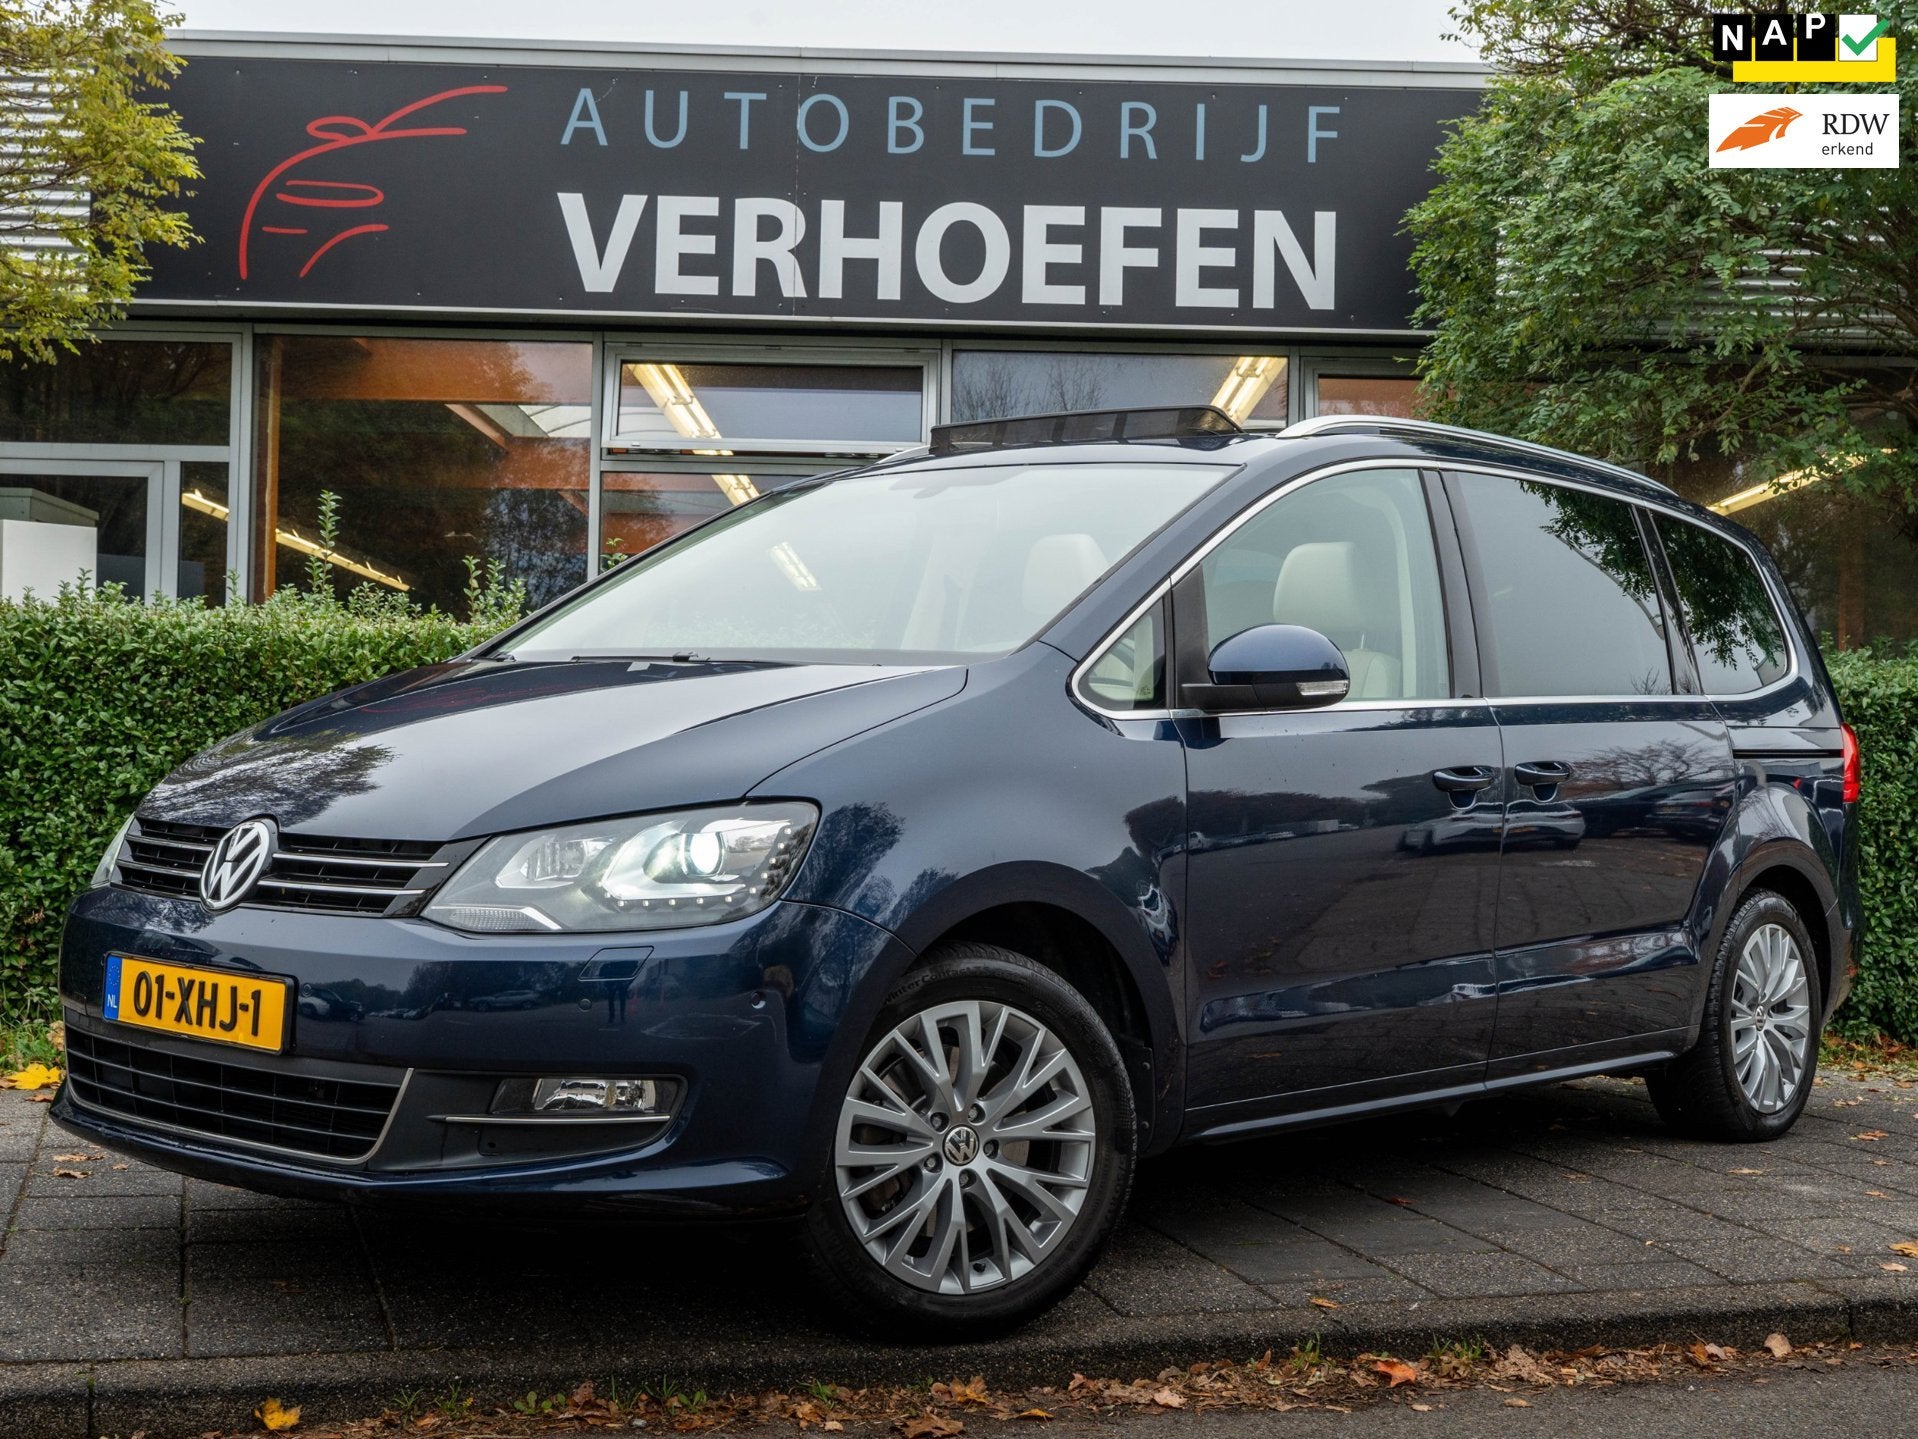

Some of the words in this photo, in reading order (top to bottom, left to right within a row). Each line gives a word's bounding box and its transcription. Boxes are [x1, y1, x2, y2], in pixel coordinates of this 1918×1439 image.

[560, 87, 1341, 164] AUTOBEDRIJF
[556, 192, 1337, 310] VERHOEFEN
[107, 994, 118, 1009] NL
[133, 970, 262, 1037] 01-XHJ-1
